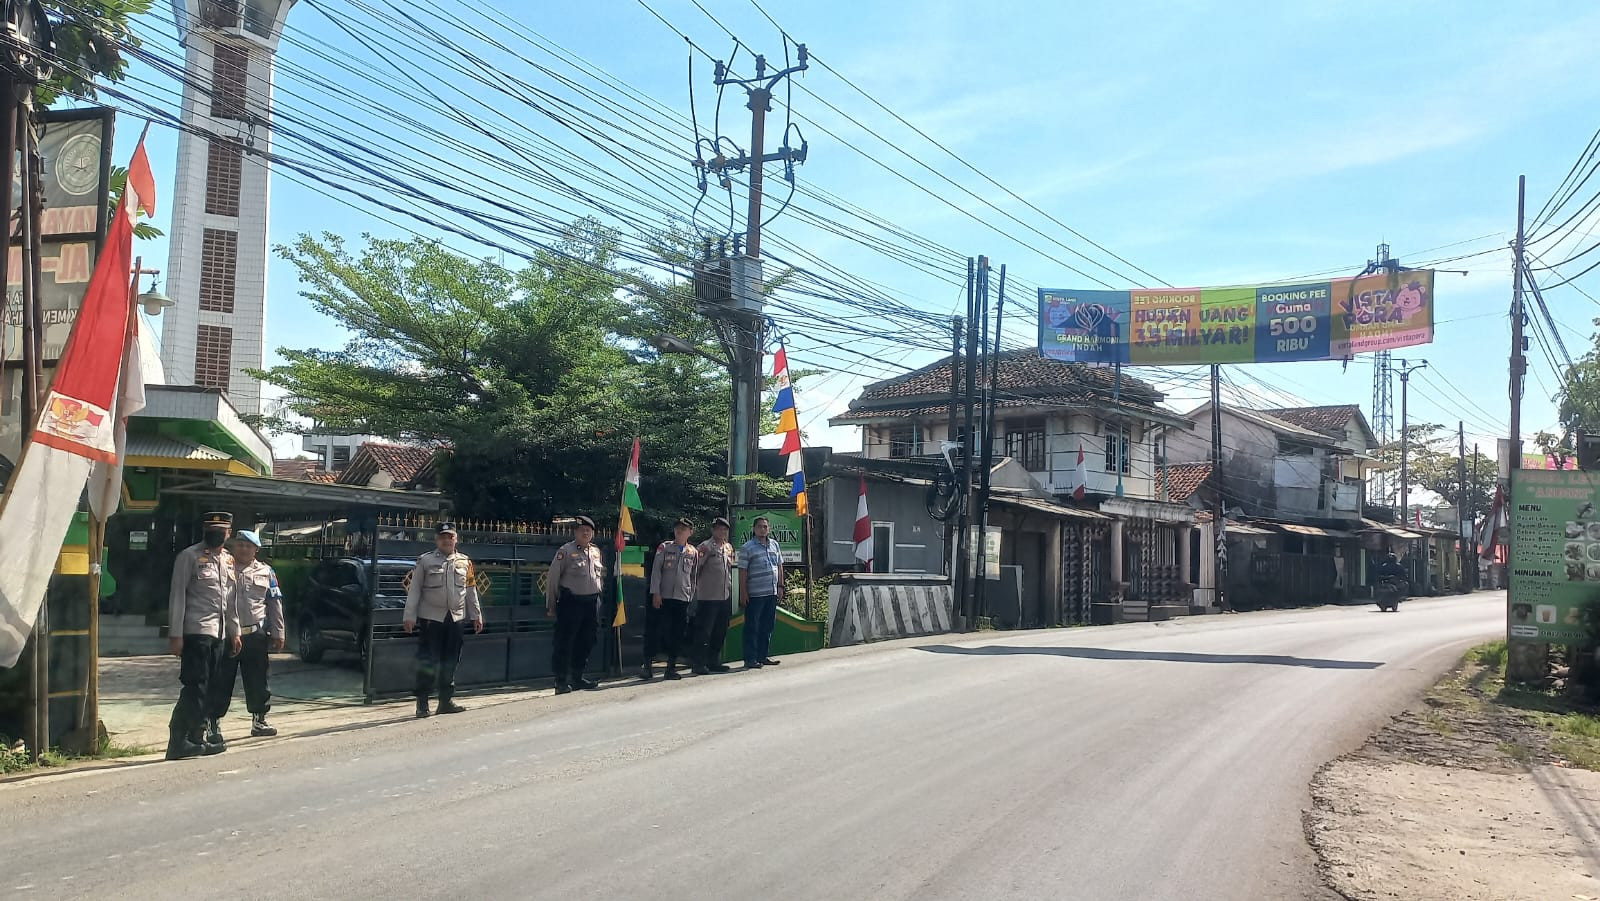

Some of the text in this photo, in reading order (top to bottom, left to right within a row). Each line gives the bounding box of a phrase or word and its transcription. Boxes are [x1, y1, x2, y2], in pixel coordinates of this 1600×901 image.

[1261, 289, 1327, 303] BOOKING FEE
[1275, 303, 1311, 314] Cuma
[1199, 307, 1248, 323] UANG
[1269, 315, 1317, 336] 500
[1057, 334, 1083, 342] GRAND
[1072, 343, 1103, 351] INDAH
[1518, 504, 1542, 512] MENU
[1514, 569, 1553, 577] MINUMAN
